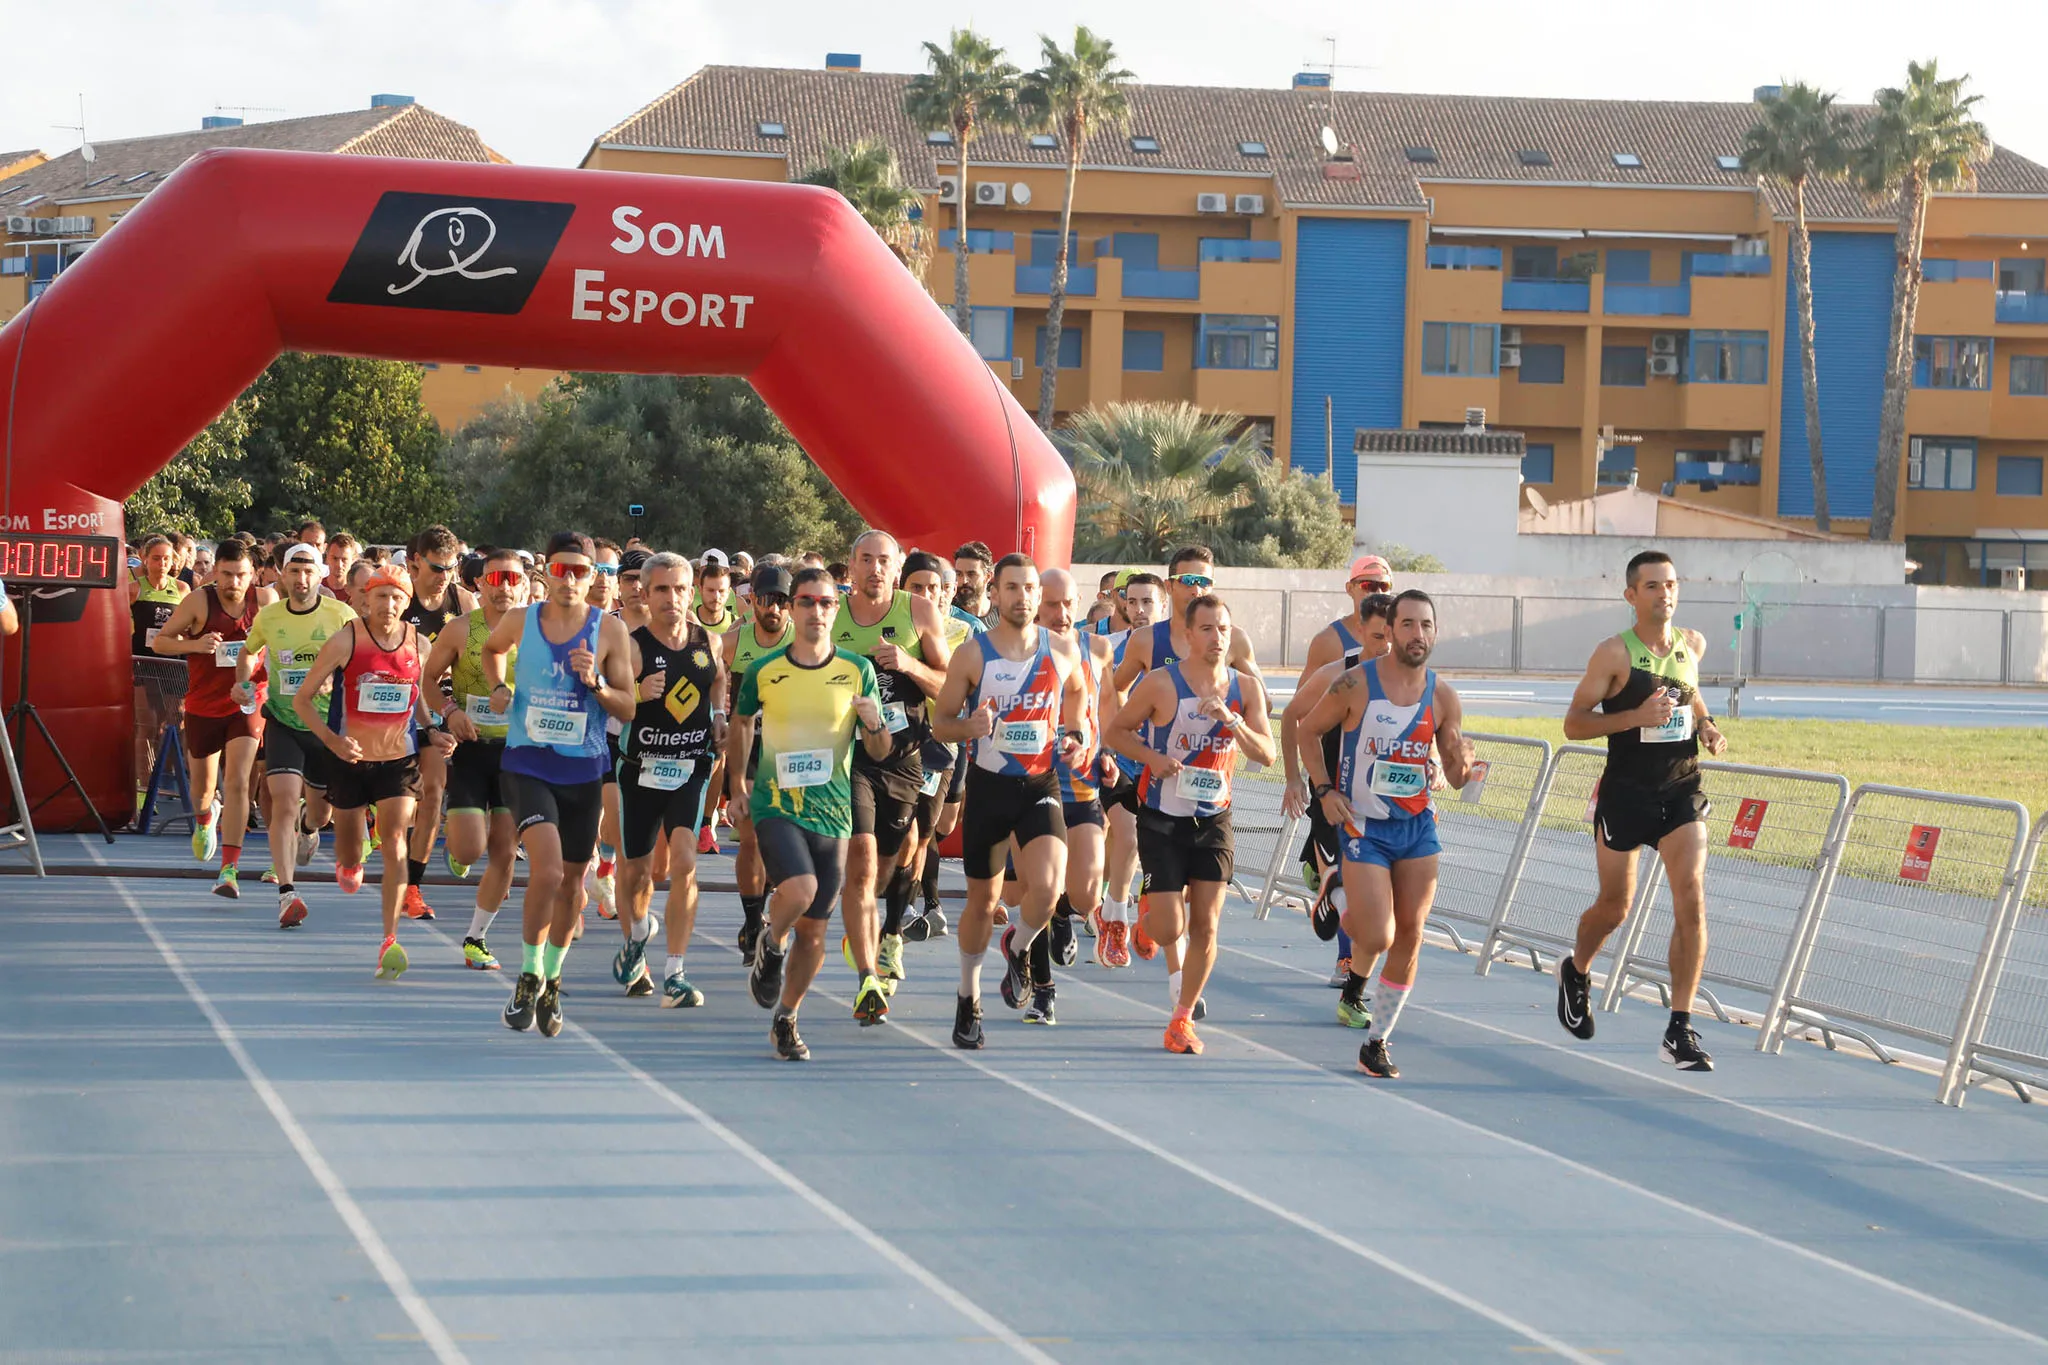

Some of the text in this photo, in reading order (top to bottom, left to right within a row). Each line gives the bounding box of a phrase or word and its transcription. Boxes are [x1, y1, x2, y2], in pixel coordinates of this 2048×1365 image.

[610, 205, 726, 259] SOM
[571, 268, 754, 329] ESPORT
[0, 508, 104, 531] OM ESPORT
[225, 648, 238, 657] A6
[373, 691, 401, 702] C659
[477, 704, 491, 714] B6
[538, 718, 574, 732] S600
[1005, 730, 1037, 741] S685
[1364, 736, 1430, 758] ALPESA
[653, 766, 682, 778] C801
[788, 760, 822, 774] B643
[1340, 755, 1351, 792] LPESA
[1190, 777, 1222, 790] A623
[1388, 772, 1417, 785] B747
